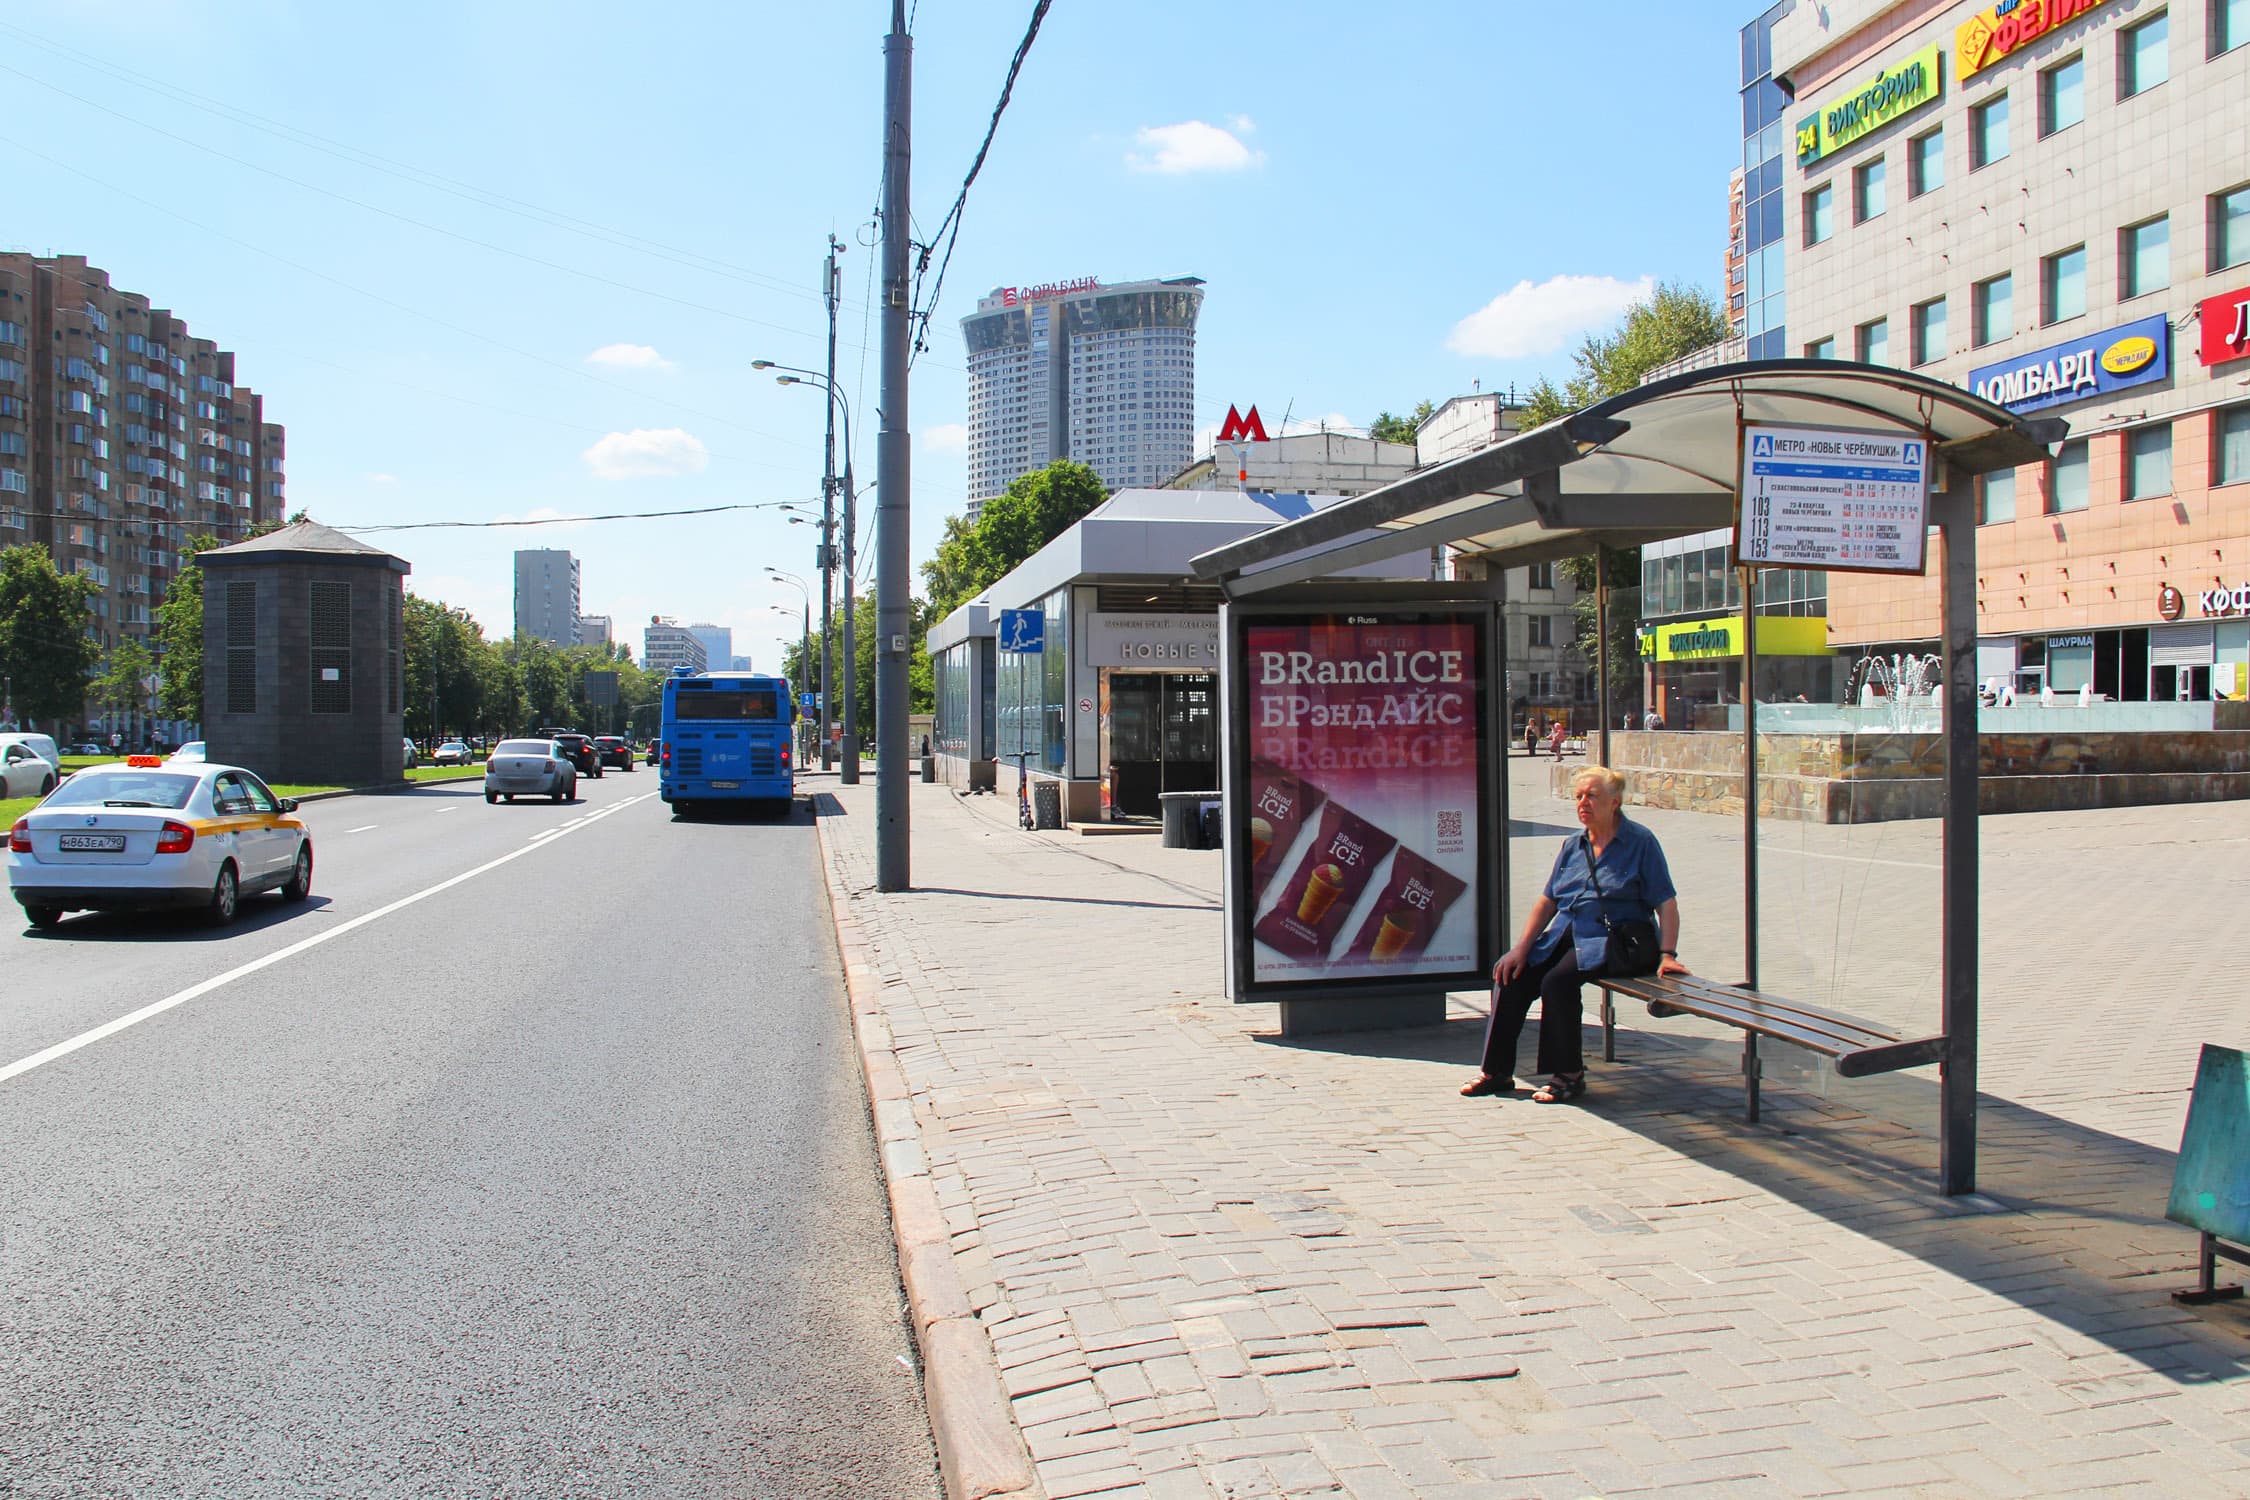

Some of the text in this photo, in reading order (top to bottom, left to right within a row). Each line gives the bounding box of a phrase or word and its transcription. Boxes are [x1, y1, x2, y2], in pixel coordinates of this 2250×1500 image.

[1797, 124, 1817, 156] 24
[1020, 275, 1098, 301] ФОРАБАНК
[1774, 440, 1805, 453] МЕТРО
[1759, 476, 1764, 496] 1
[1752, 496, 1770, 517] 103
[1752, 517, 1769, 538] 113
[1750, 537, 1768, 558] 153
[1357, 615, 1378, 624] Russ
[1122, 643, 1197, 659] НОВЫЕ
[1640, 633, 1655, 656] 24
[2048, 635, 2092, 648] ШАУРМА
[1259, 650, 1463, 685] BRandICE
[1260, 687, 1463, 729] БРэндАЙС
[1257, 793, 1289, 820] ICE
[1265, 785, 1293, 807] BRand
[1328, 841, 1359, 866] ICE
[1336, 832, 1364, 853] BRand
[1400, 885, 1430, 910] ICE
[1408, 876, 1434, 898] BRand
